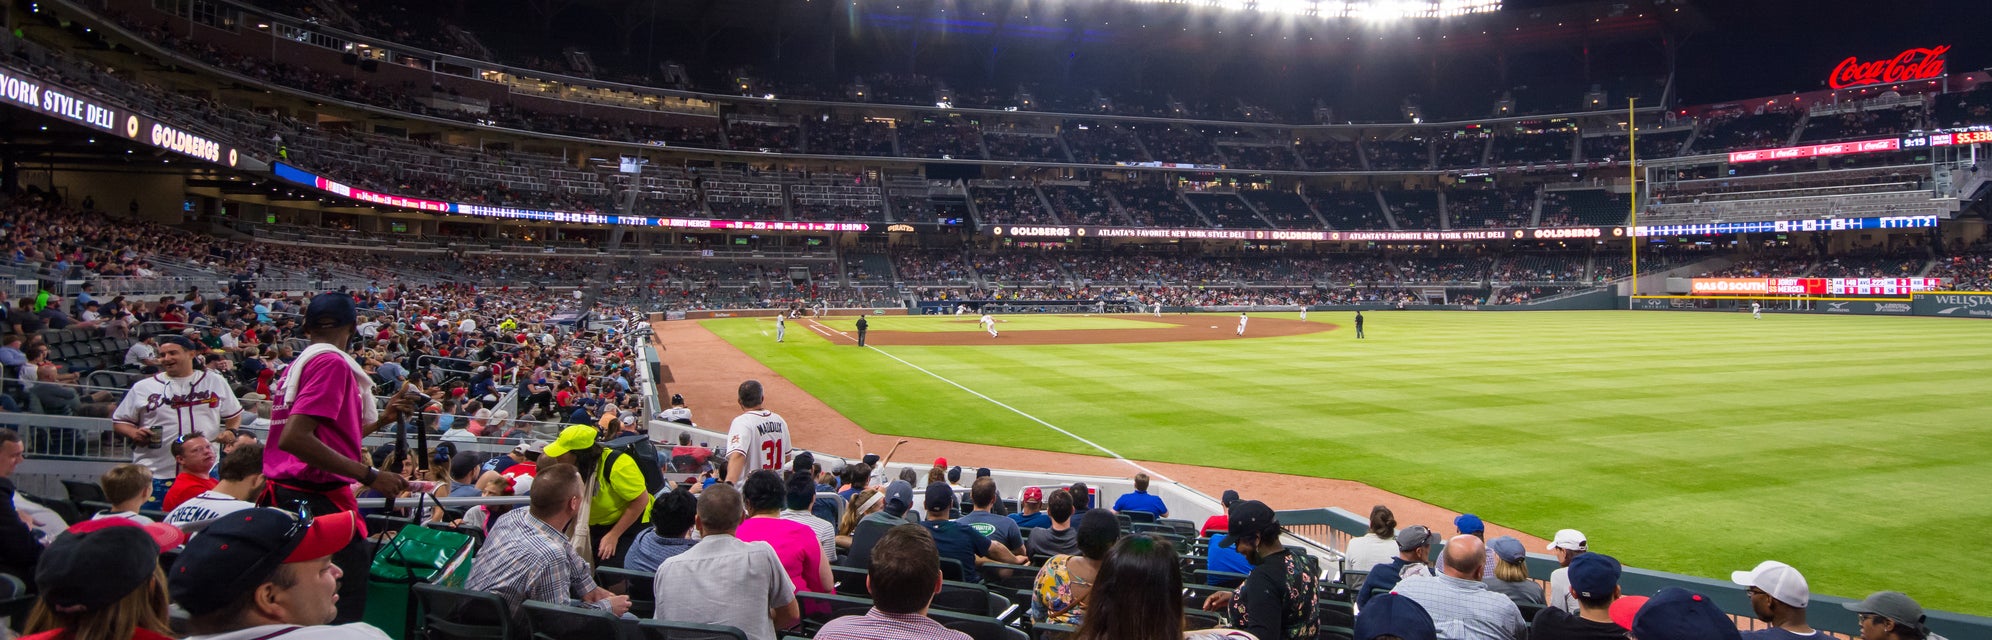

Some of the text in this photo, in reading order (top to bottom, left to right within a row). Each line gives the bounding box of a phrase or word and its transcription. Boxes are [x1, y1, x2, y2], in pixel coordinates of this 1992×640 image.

[1829, 45, 1951, 89] Coca-Cola
[0, 73, 114, 129] YORK STYLE DELI
[152, 123, 220, 162] GOLDBERGS
[1904, 138, 1926, 147] 9:19
[687, 219, 710, 228] MERCER
[1719, 222, 1772, 233] 6 7 8 9
[1010, 226, 1070, 237] GOLDBERGS
[1097, 229, 1136, 237] ATLANTA'S
[1136, 229, 1170, 237] FAVORITE
[1171, 230, 1187, 238] NEW
[1187, 230, 1207, 238] YORK
[1229, 231, 1245, 239] DELI
[1272, 231, 1324, 240] GOLDBERGS
[1349, 232, 1387, 240] ATLANTA'S
[1387, 232, 1422, 240] FAVORITE
[1423, 232, 1440, 240] NEW
[1487, 231, 1506, 239] DELI
[1533, 228, 1601, 238] GOLDBERGS
[1695, 281, 1766, 291] GAS SOUTH
[757, 421, 783, 436] MADDUX
[761, 438, 783, 470] 31
